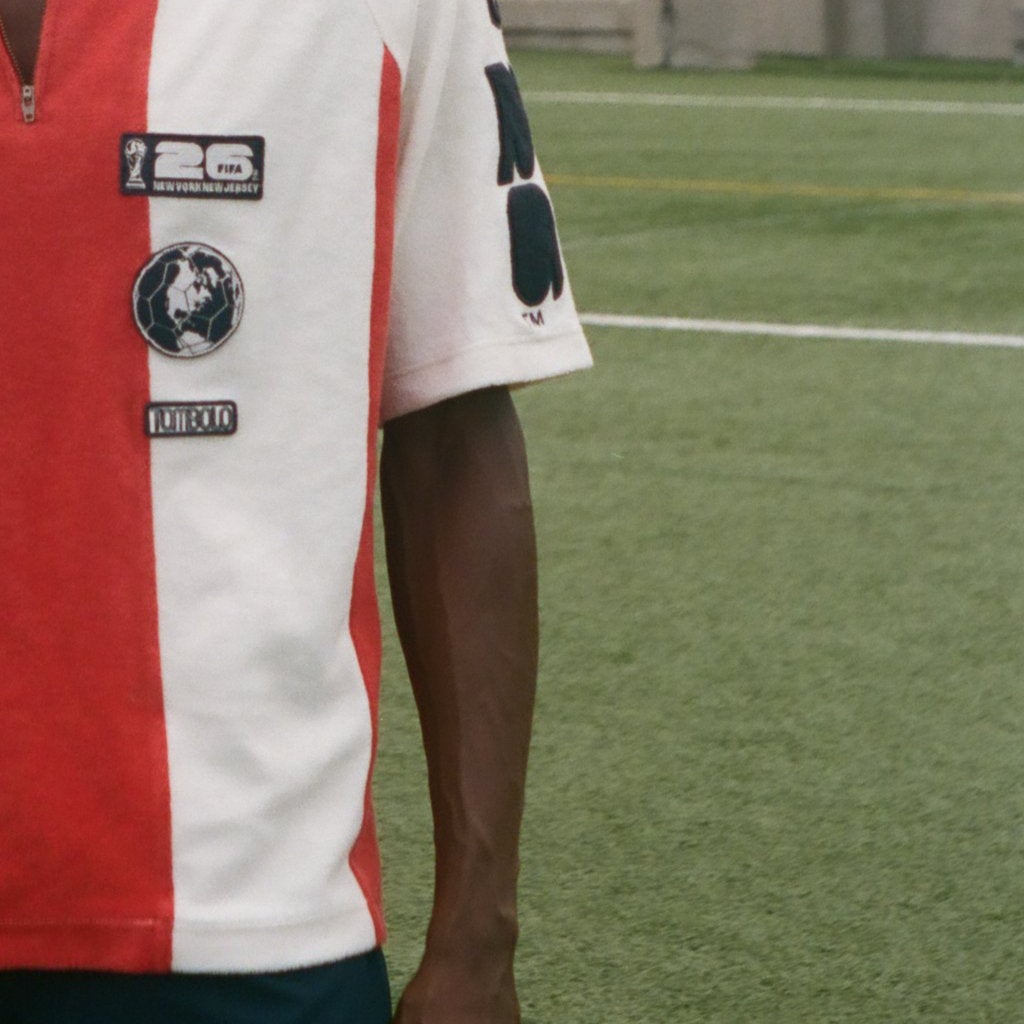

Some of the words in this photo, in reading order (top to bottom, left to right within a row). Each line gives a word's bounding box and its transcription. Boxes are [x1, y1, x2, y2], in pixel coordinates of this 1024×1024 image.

[154, 141, 254, 180] 26
[217, 163, 243, 174] FIFA
[153, 180, 175, 191] NEW
[176, 181, 202, 192] YORK
[203, 181, 223, 192] NEW
[224, 182, 259, 194] JERSEY
